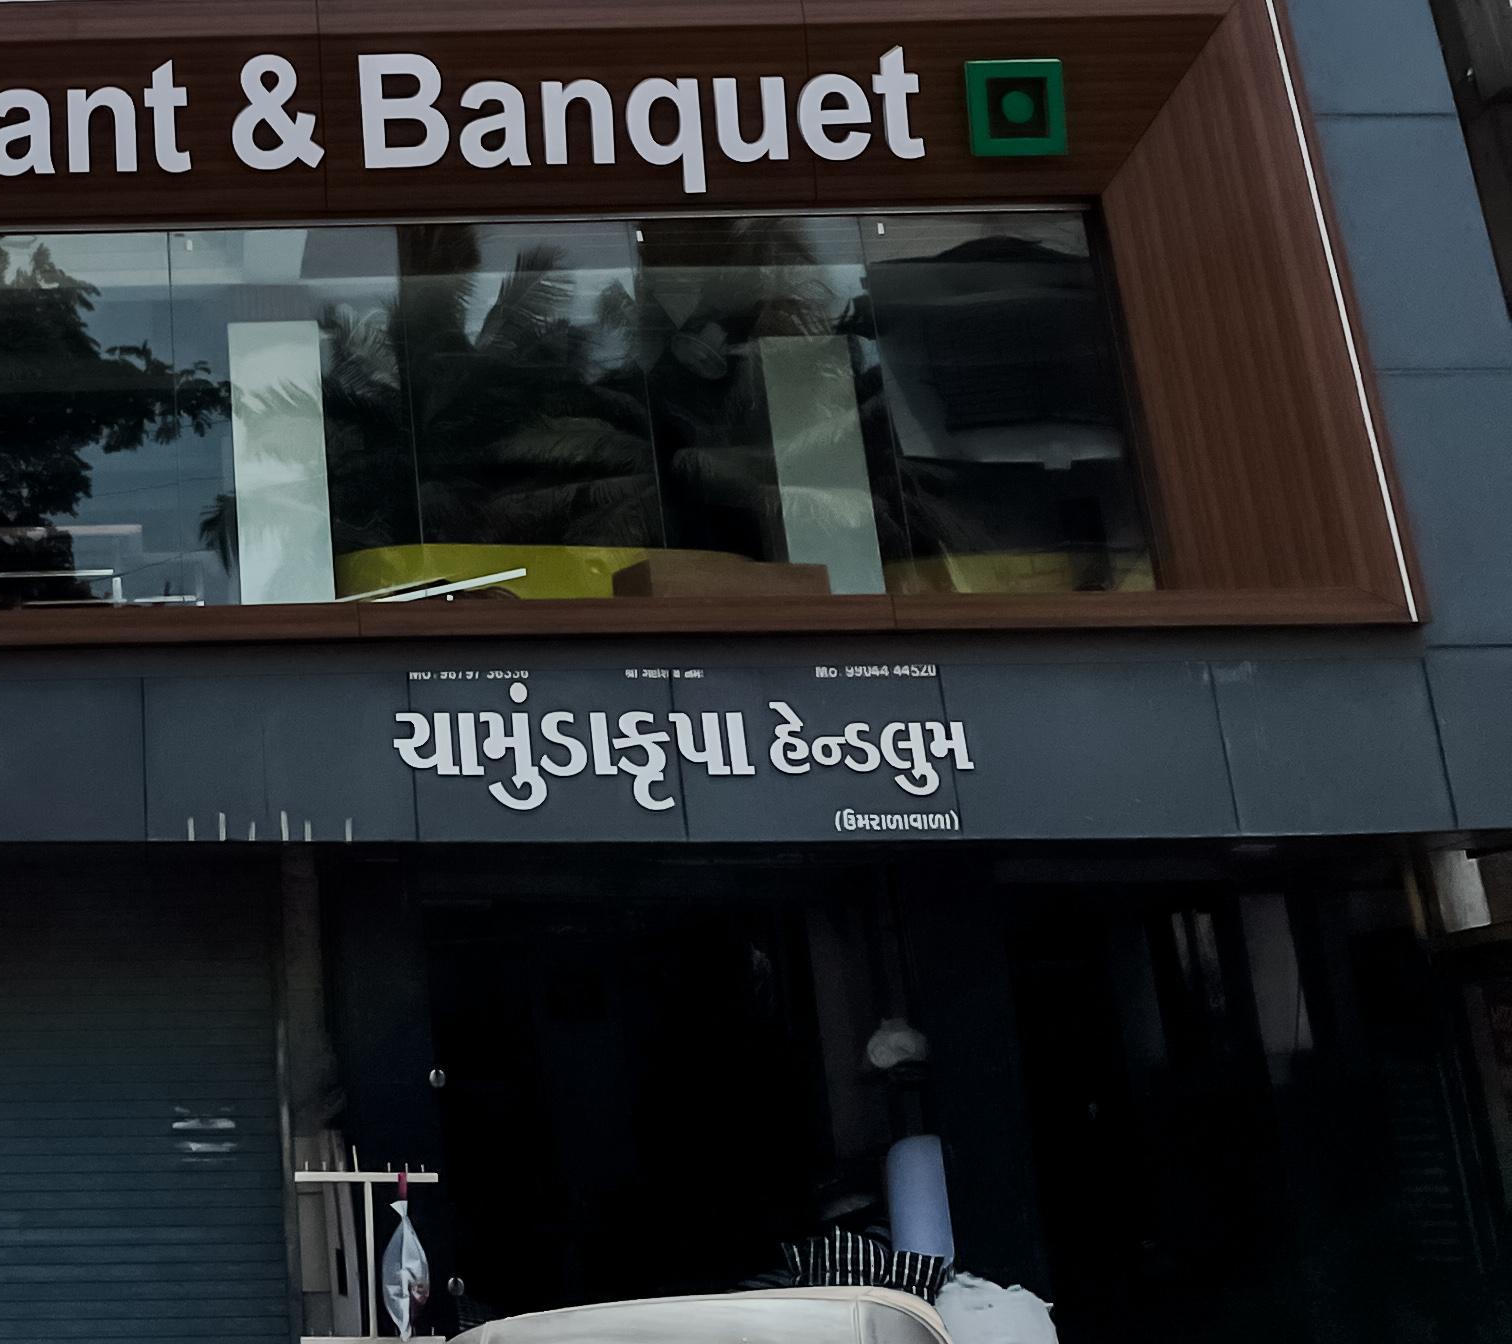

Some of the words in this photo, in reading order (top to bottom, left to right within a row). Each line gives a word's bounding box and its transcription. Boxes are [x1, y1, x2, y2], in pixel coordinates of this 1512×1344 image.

[232, 54, 326, 175] &
[358, 45, 926, 194] Banquet
[769, 702, 974, 795] હેન્ડલુમ
